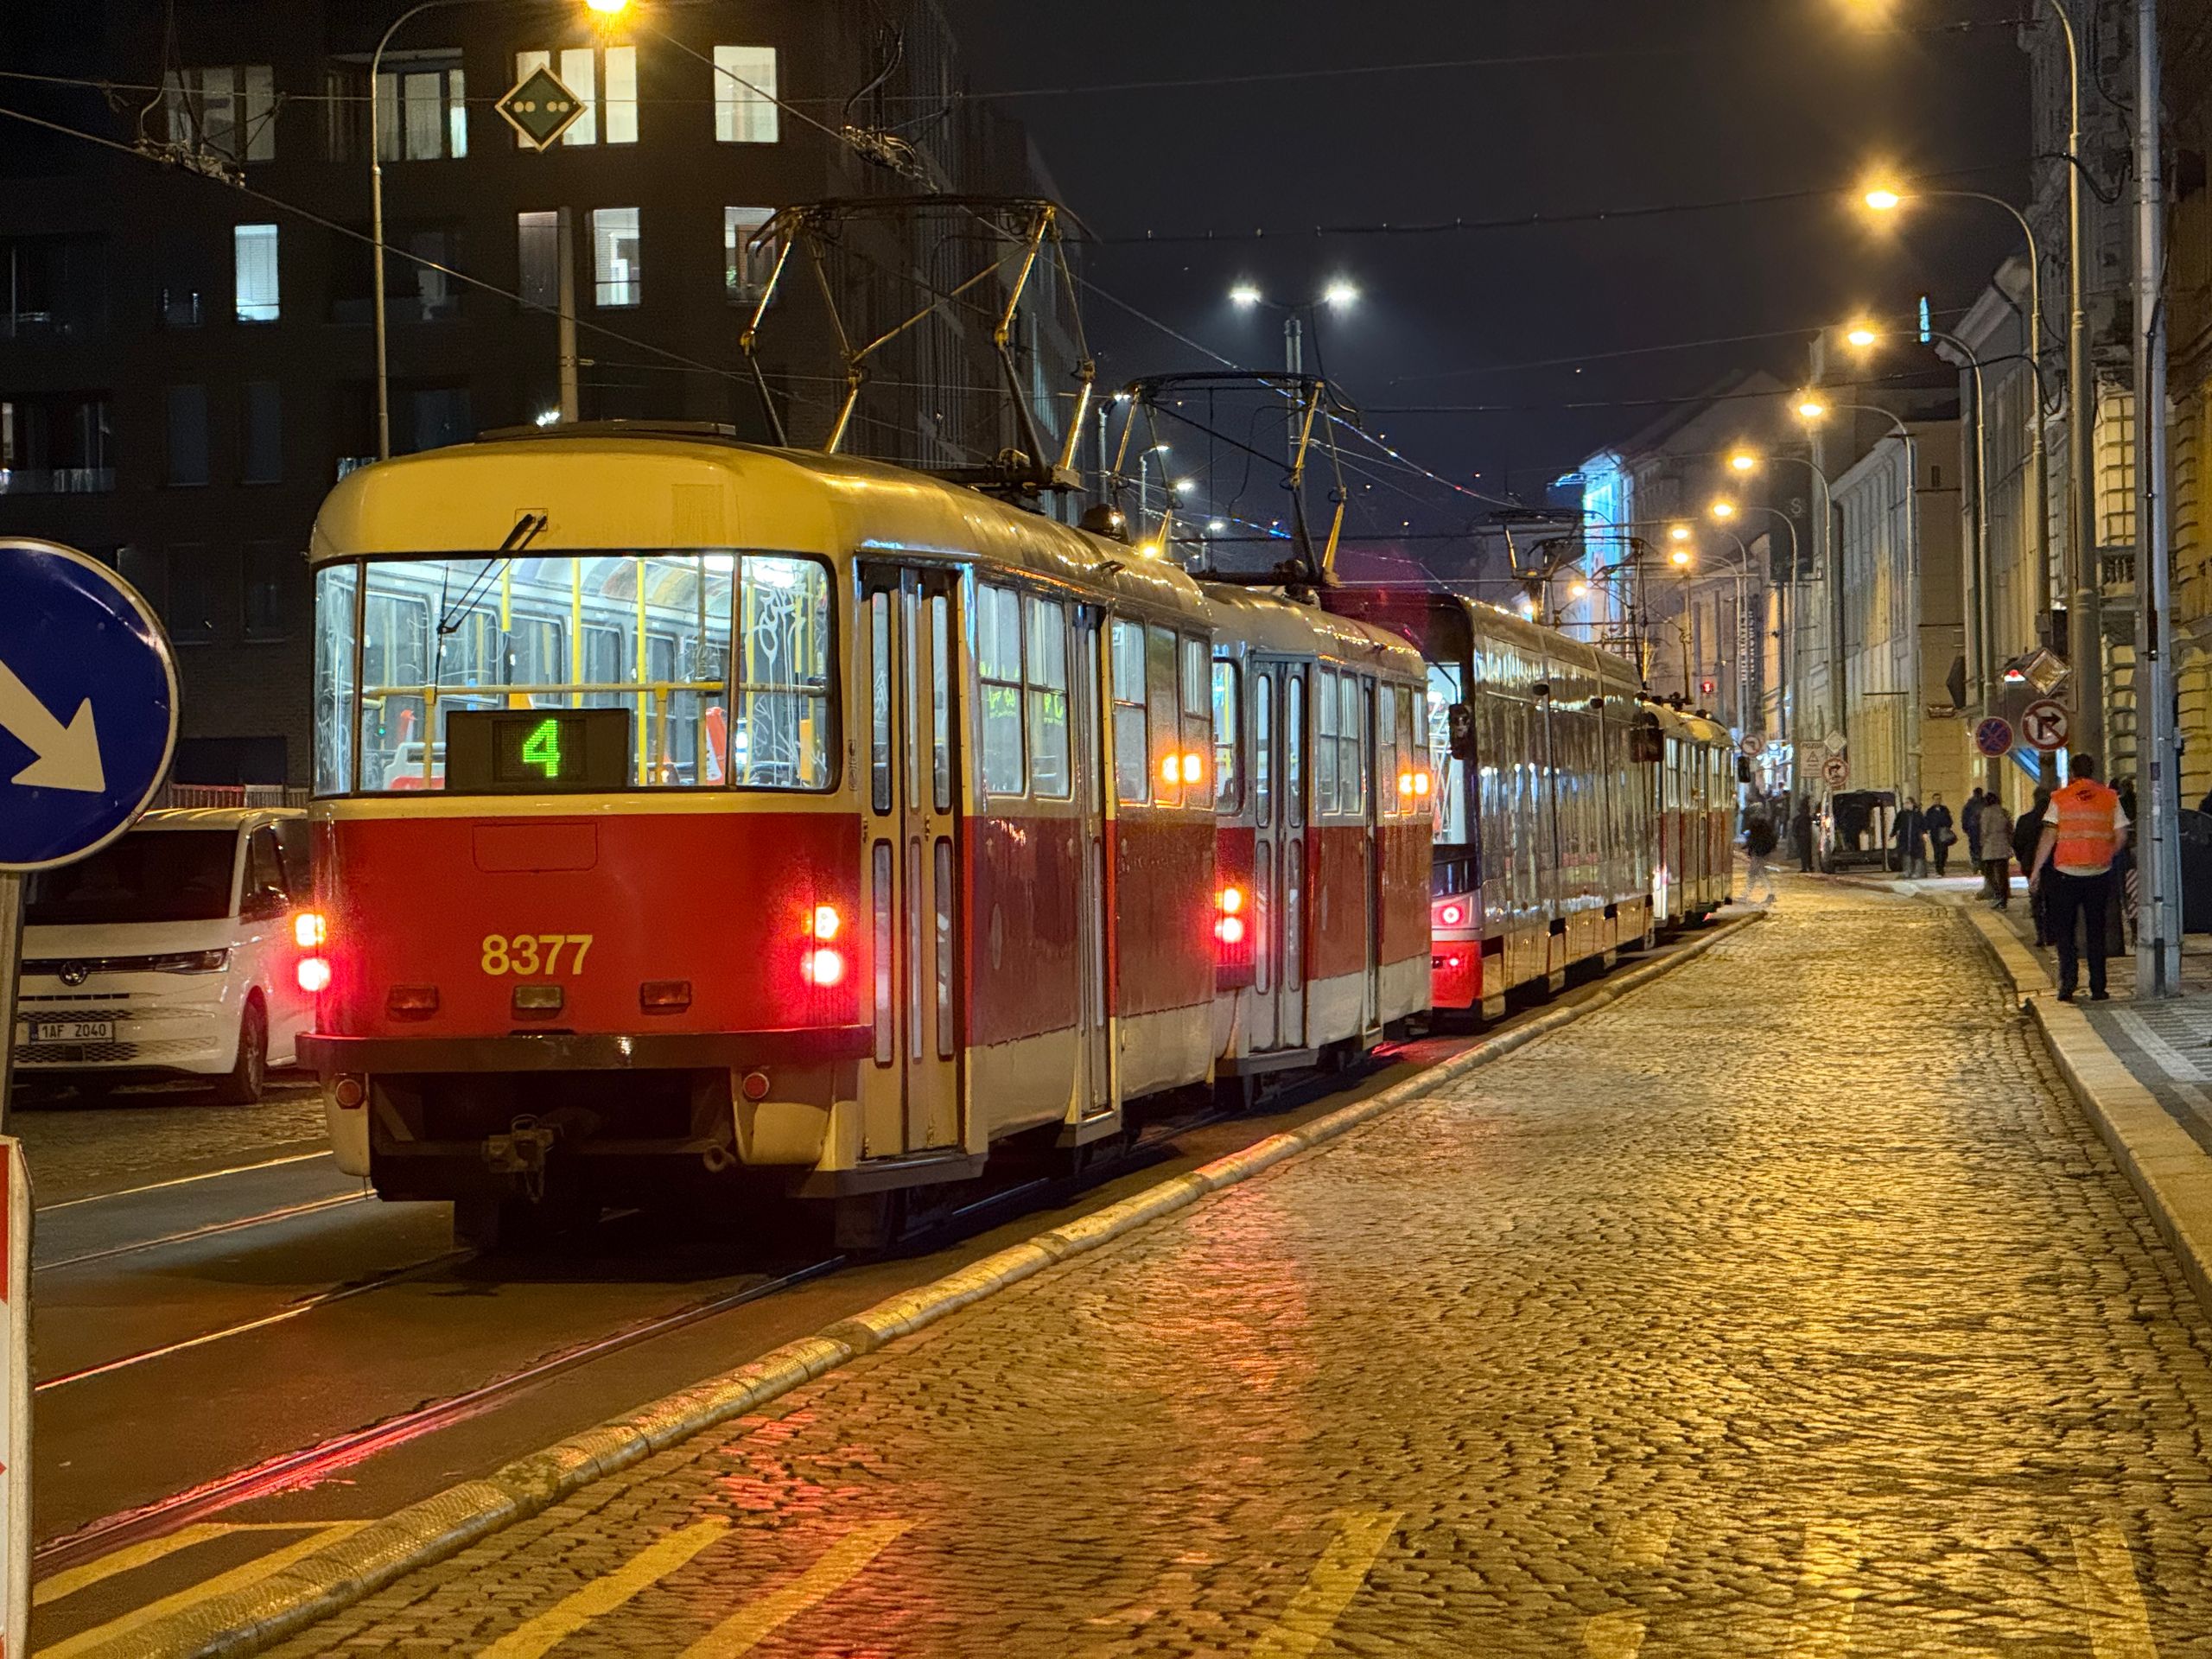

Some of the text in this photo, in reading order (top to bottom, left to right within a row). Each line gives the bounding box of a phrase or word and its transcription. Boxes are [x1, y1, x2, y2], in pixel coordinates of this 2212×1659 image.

[523, 719, 561, 777] 4
[481, 934, 594, 976] 8377
[41, 1025, 65, 1039] 1AF
